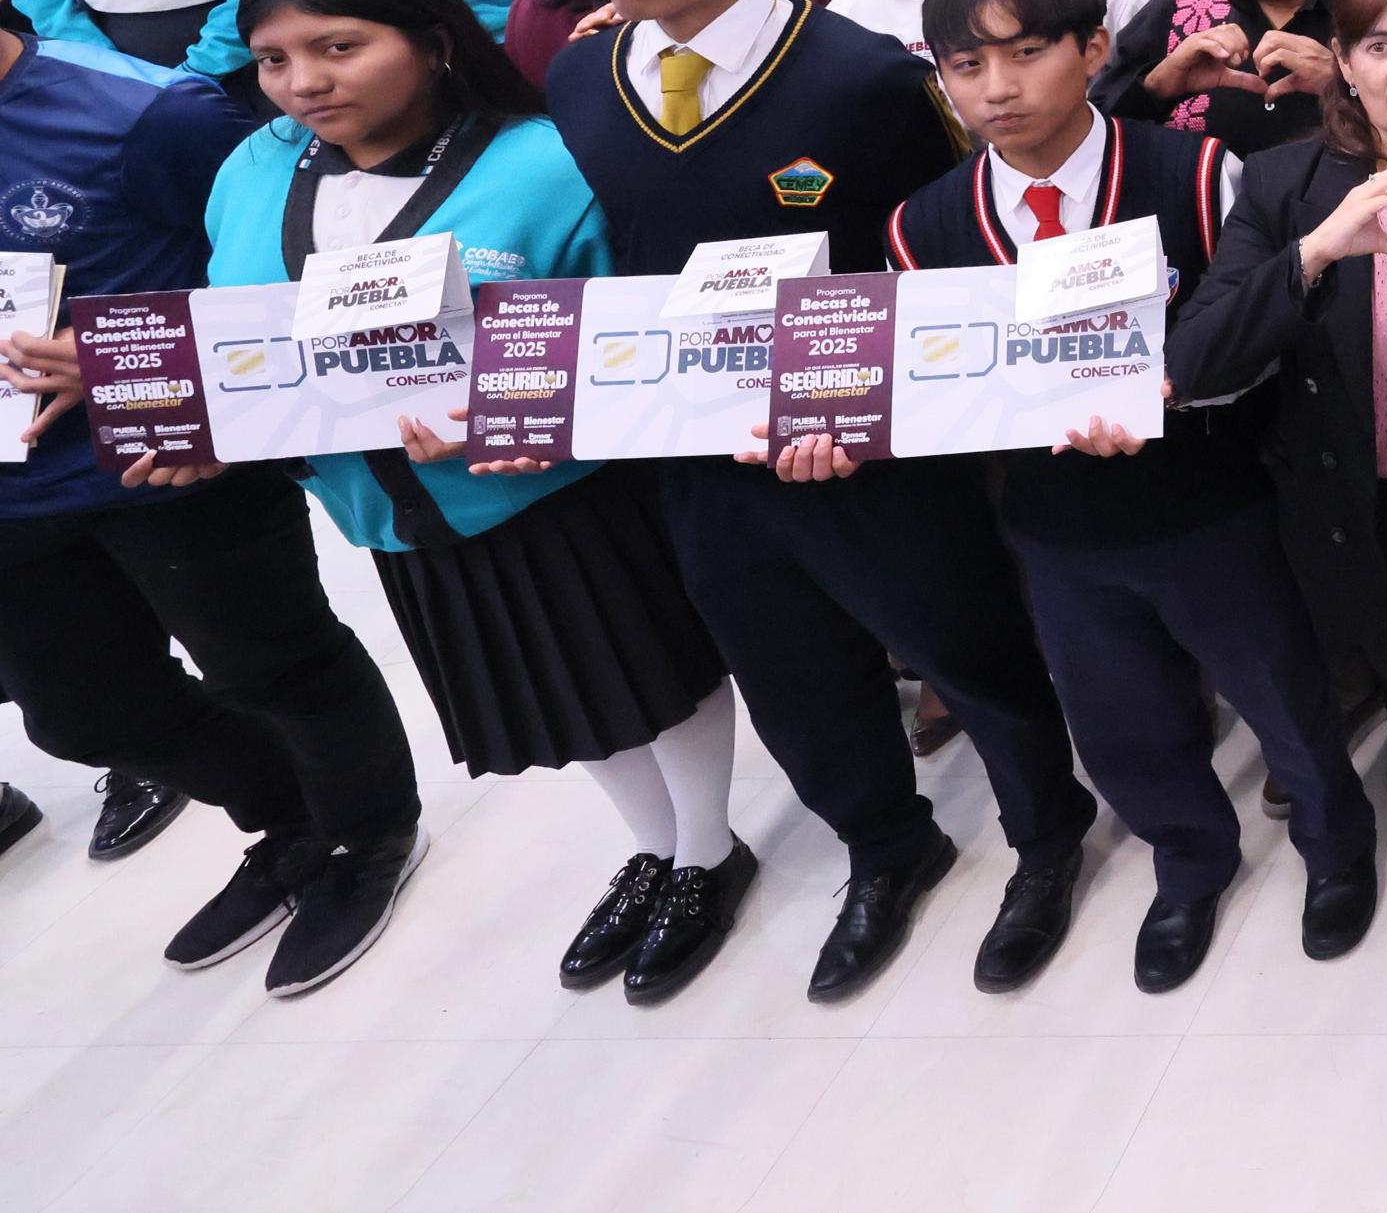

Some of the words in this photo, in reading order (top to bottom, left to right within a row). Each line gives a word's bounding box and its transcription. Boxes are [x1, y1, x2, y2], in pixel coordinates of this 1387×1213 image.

[357, 251, 382, 262] BECA
[385, 250, 396, 258] DE
[721, 249, 785, 260] CONECTIVIDAD
[739, 245, 760, 253] BECA
[340, 255, 411, 272] CONECTIVIDAD
[724, 267, 768, 278] AMOR
[1050, 266, 1124, 292] PUEBLA
[350, 276, 398, 293] AMOR
[700, 276, 772, 292] PUEBLA
[328, 285, 408, 310] PUEBLA
[801, 298, 847, 311] Becas
[851, 296, 870, 307] de
[109, 307, 149, 315] Programa
[370, 300, 403, 311] CONECTA
[499, 302, 539, 314] Becas
[542, 301, 559, 312] de
[96, 316, 143, 328] Becas
[146, 314, 166, 325] de
[482, 314, 573, 328] Conectividad
[782, 309, 887, 327] Conectividad
[1129, 317, 1141, 329] A
[81, 325, 185, 343] Conectividad
[312, 337, 350, 351] POR
[350, 322, 438, 348] AMOR
[440, 327, 451, 340] A
[491, 333, 510, 342] para
[522, 331, 561, 339] Bienestar
[680, 332, 712, 346] POR
[712, 324, 774, 345] AMO
[793, 330, 816, 339] para
[819, 328, 827, 336] el
[830, 326, 874, 335] Bienestar
[96, 346, 118, 355] para
[121, 344, 129, 352] el
[131, 342, 175, 351] Bienestar
[504, 342, 546, 357] 2025
[809, 337, 857, 356] 2025
[1006, 331, 1150, 365] PUEBLA
[113, 353, 162, 370] 2025
[314, 342, 466, 376] PUEBLA
[678, 345, 773, 374] PUEB
[1071, 364, 1139, 378] CONECTA
[386, 372, 457, 387] CONECTA
[477, 371, 567, 392] SEGURIDAD
[737, 378, 771, 389] CONE
[780, 367, 883, 392] SEGURIDAD
[92, 379, 194, 404] SEGURIDAD
[504, 389, 555, 399] bienestar
[811, 386, 870, 399] bienestar
[126, 398, 182, 410] bienestar
[524, 416, 565, 424] Bienestar
[792, 416, 826, 424] PUEBLA
[835, 414, 882, 424] Bienestar
[113, 426, 146, 434] PUEBLA
[155, 424, 200, 432] Bienestar
